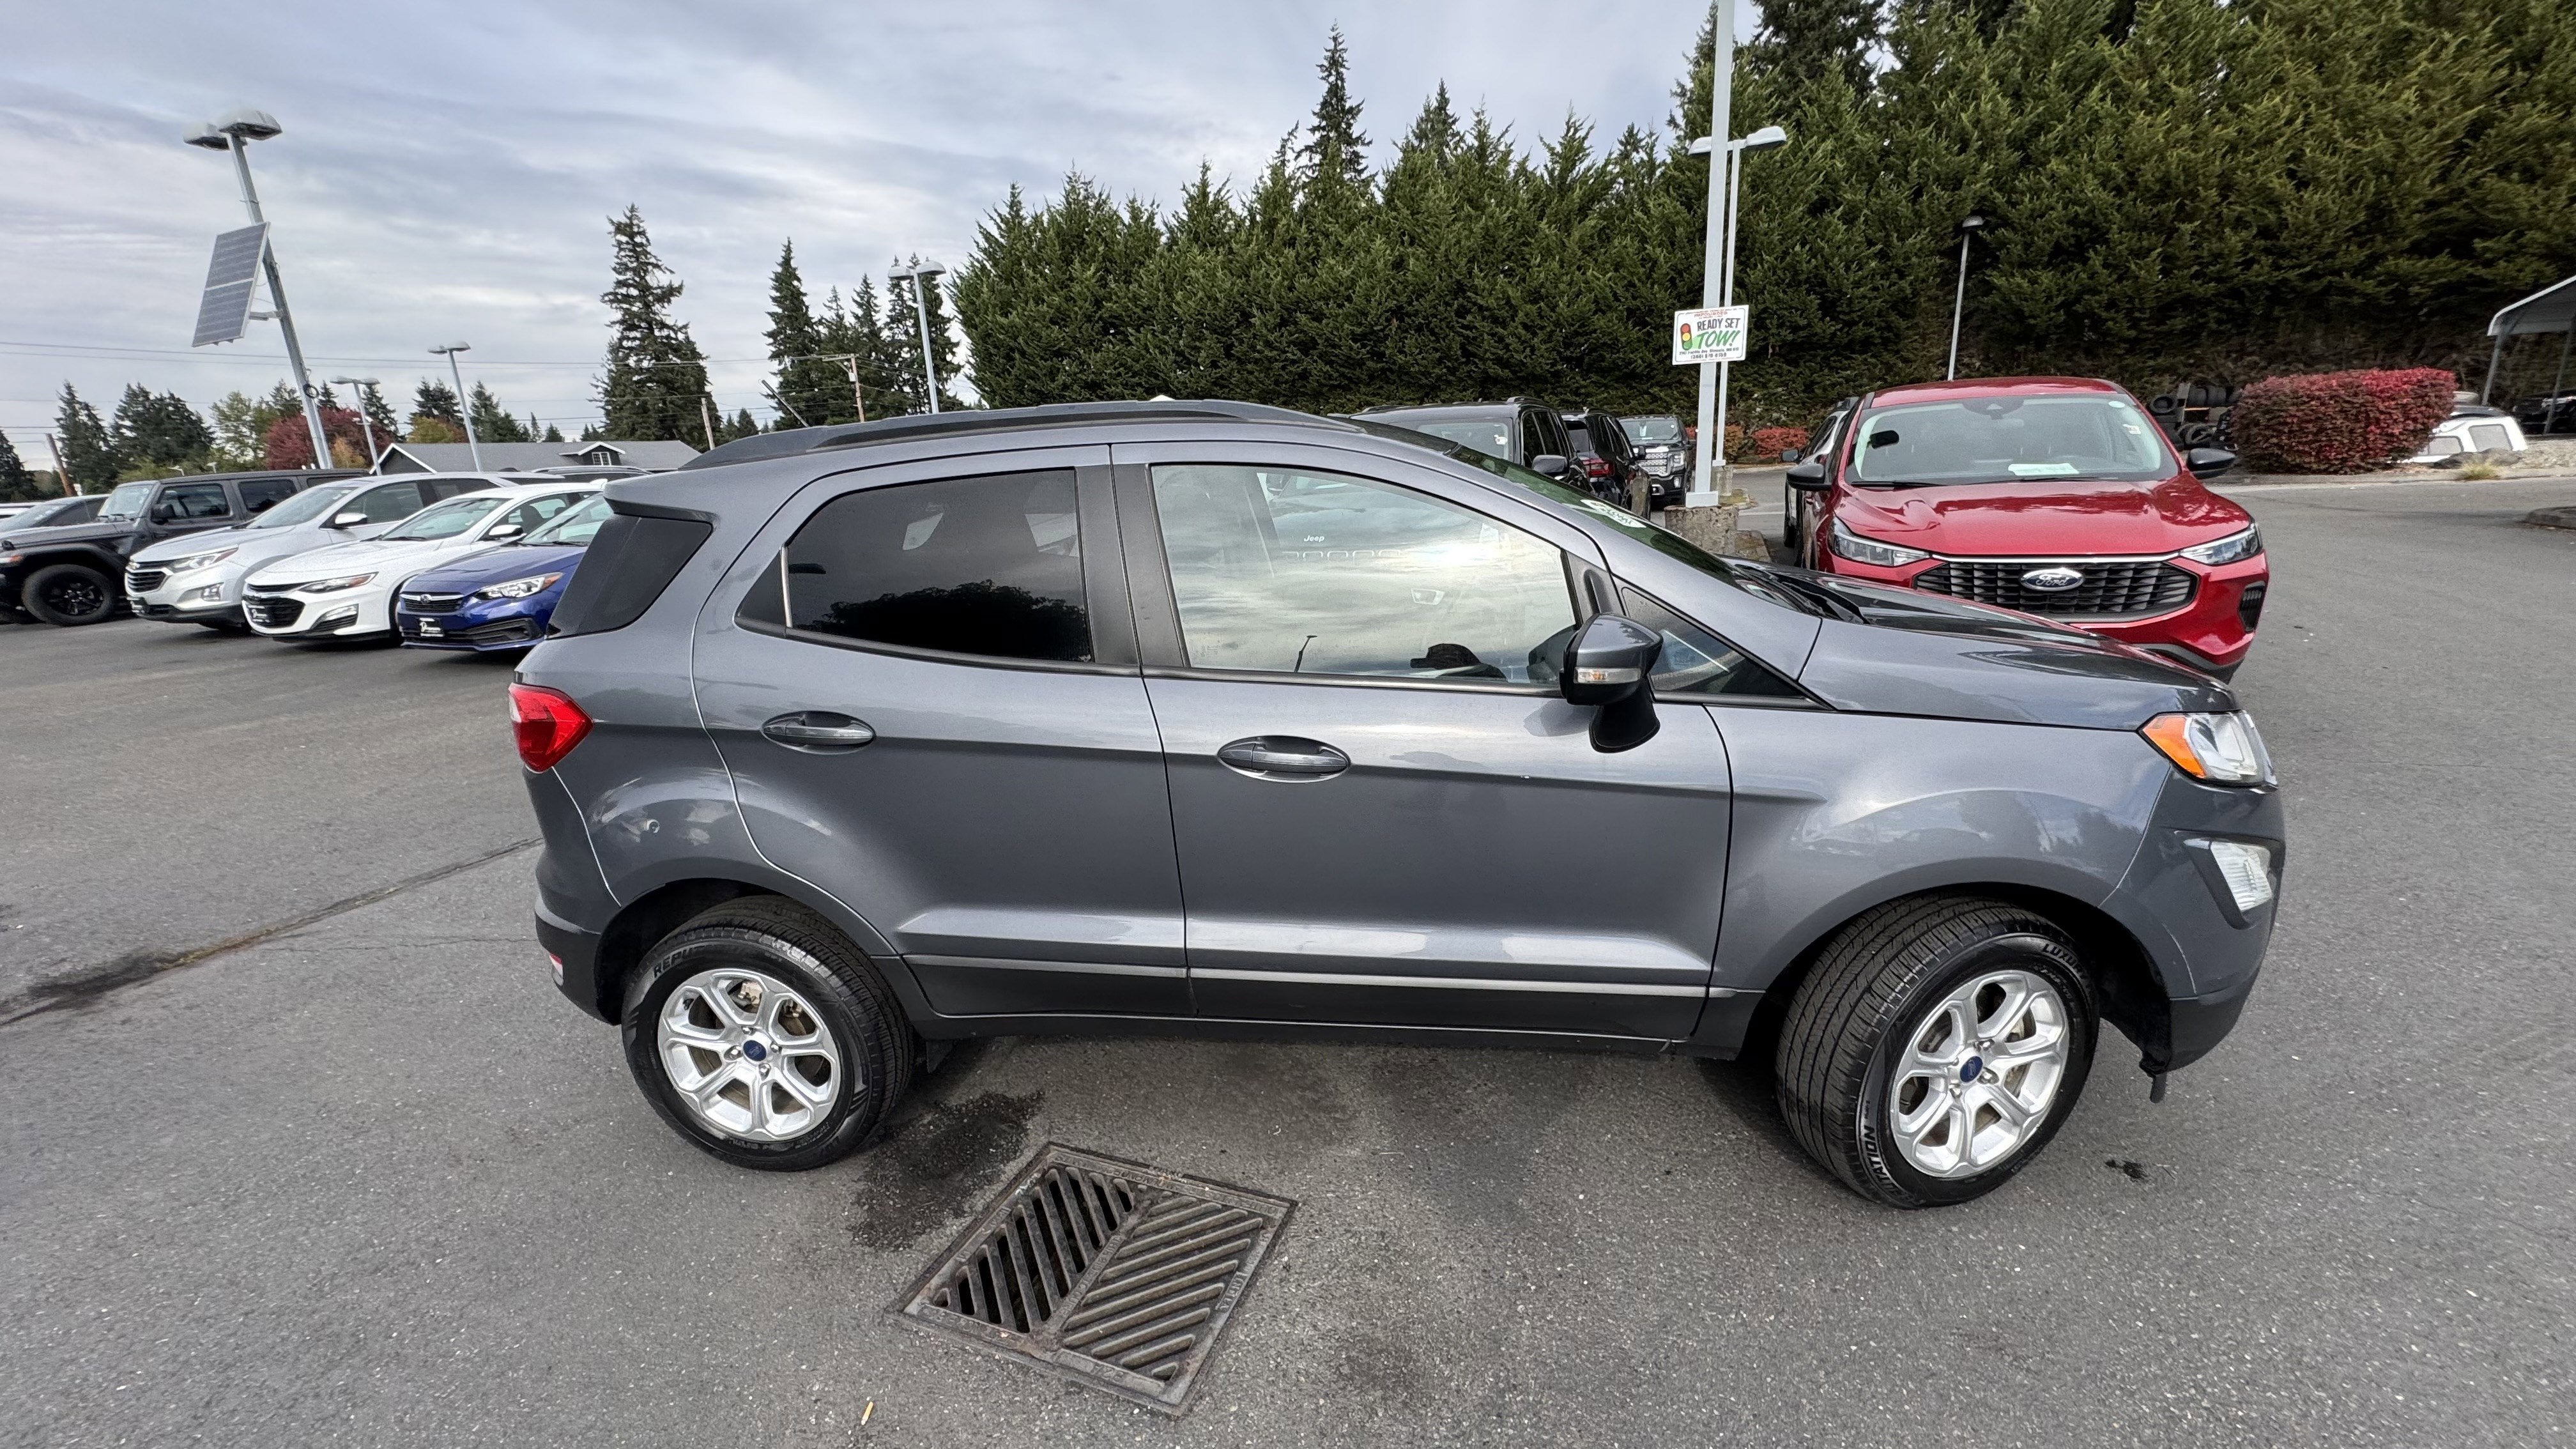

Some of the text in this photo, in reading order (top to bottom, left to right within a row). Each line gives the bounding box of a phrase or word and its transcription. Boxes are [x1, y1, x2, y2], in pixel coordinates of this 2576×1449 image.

[1697, 318, 1741, 331] READY SET
[1697, 330, 1741, 349] TOW!
[2035, 574, 2070, 586] Ford
